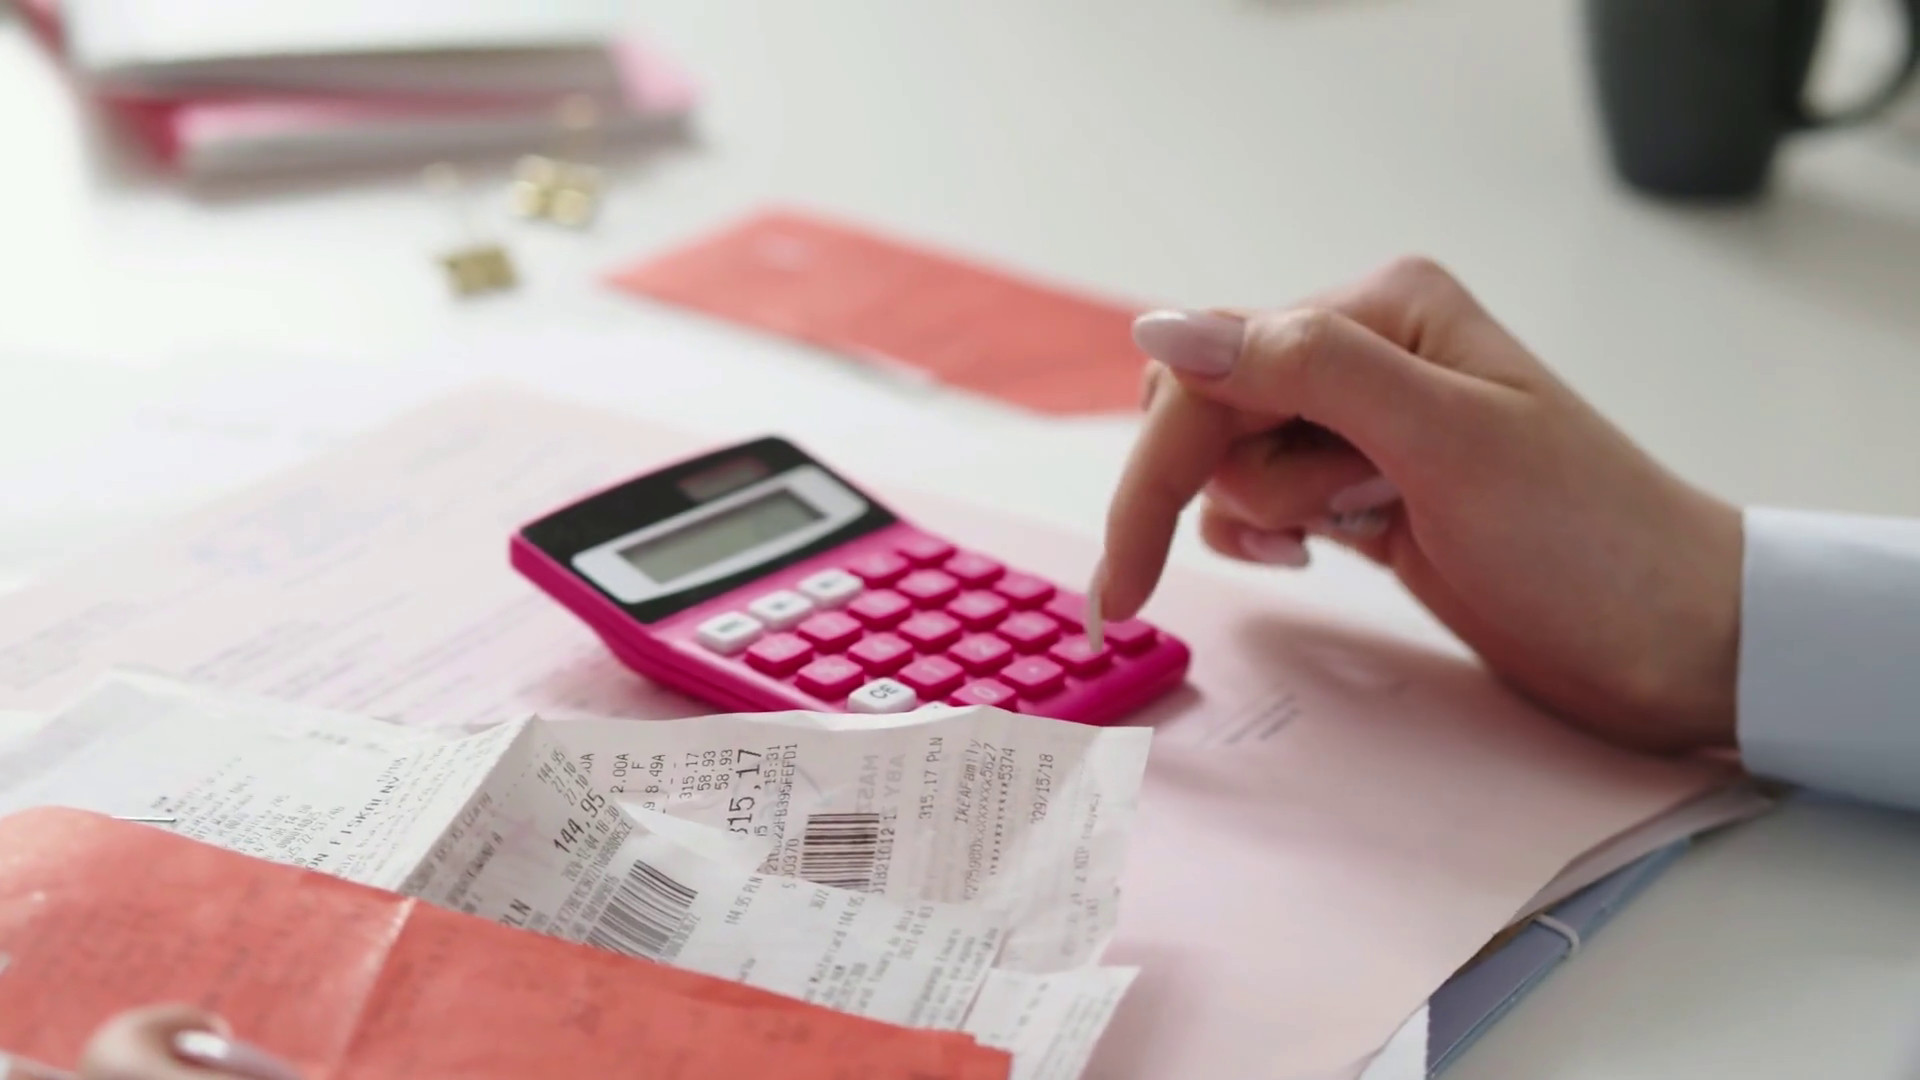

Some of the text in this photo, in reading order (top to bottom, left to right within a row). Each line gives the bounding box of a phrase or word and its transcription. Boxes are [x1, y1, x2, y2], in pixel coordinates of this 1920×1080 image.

[869, 683, 899, 699] CE
[926, 737, 943, 763] PLN
[763, 744, 781, 785] 15:31
[553, 787, 606, 854] 144,95
[742, 876, 764, 895] PLN
